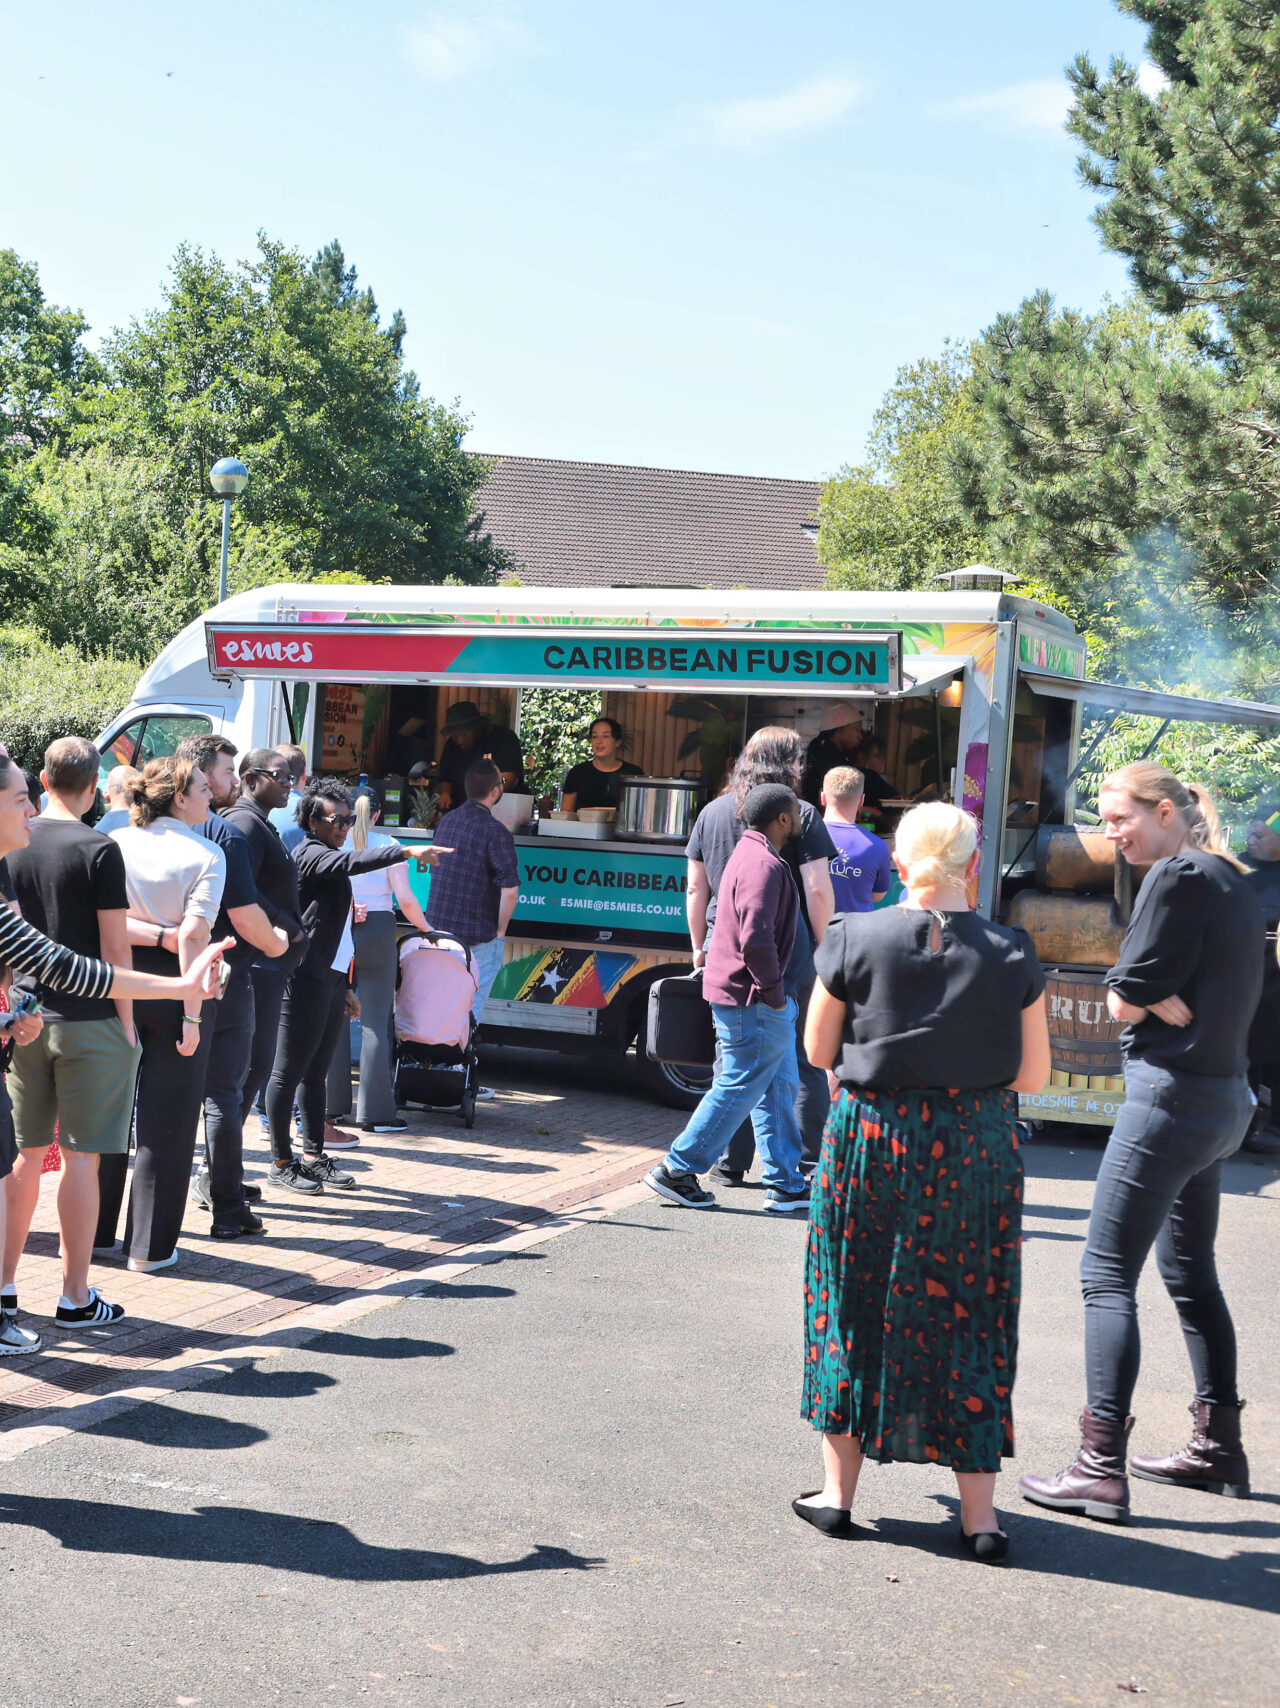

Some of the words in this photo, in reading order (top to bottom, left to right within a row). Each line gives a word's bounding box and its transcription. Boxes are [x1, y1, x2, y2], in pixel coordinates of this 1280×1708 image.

[222, 637, 313, 663] esmies
[543, 645, 738, 673] CARIBBEAN
[746, 649, 876, 676] FUSION
[324, 712, 347, 723] SION
[326, 701, 358, 714] BBEAN
[524, 865, 567, 884] YOU
[517, 894, 546, 905] O.UK
[560, 898, 682, 916] ESMIE@ESMIES.CO.UK
[1051, 995, 1121, 1024] RU
